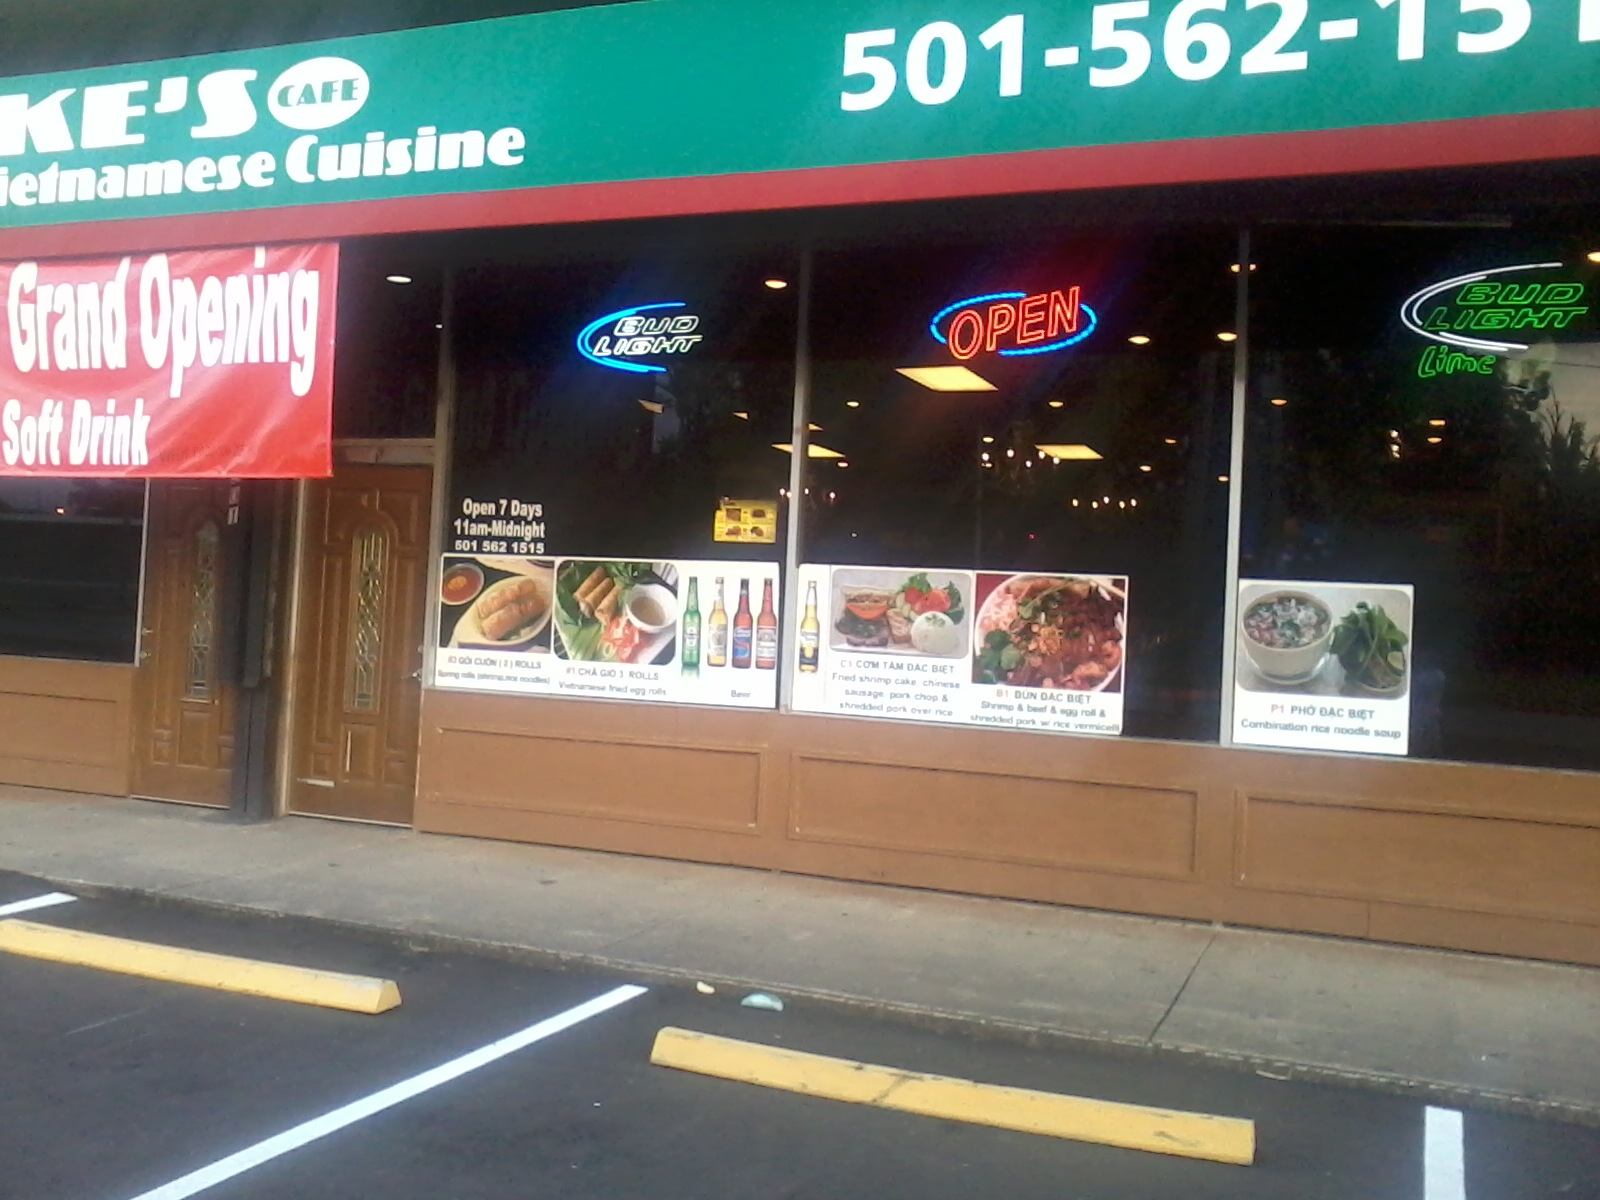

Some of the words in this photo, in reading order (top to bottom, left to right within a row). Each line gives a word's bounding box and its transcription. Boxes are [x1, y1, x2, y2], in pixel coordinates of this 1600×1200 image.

[277, 77, 361, 108] CAFE
[285, 125, 526, 184] Cuisine
[1456, 281, 1585, 305] BUD
[7, 256, 131, 373] Grand
[139, 245, 320, 399] Opening
[613, 315, 700, 336] BUD
[948, 285, 1081, 361] OPEN
[1421, 306, 1590, 331] LIGHT
[592, 335, 703, 356] LIGHT
[1417, 344, 1496, 378] Lime
[2, 398, 63, 466] Soft
[69, 397, 150, 466] Drink
[462, 497, 496, 520] Open
[499, 498, 508, 516] 7
[511, 499, 543, 521] Days
[454, 518, 546, 541] 11am-Midnight
[455, 539, 478, 552] 501
[482, 541, 507, 553] 562
[511, 541, 545, 554] 1515
[628, 670, 660, 681] ROLLS
[832, 672, 856, 682] Fried
[859, 673, 892, 686] shrimp
[894, 677, 917, 686] cake
[922, 677, 961, 689] chinese
[558, 680, 607, 692] Vietnamese
[630, 686, 646, 697] egg
[648, 686, 667, 696] rolls
[731, 689, 751, 698] Beer
[844, 688, 885, 700] sausage
[889, 690, 911, 700] pork
[914, 692, 939, 703] chop
[839, 701, 884, 712] shredded
[886, 704, 908, 714] pork
[911, 706, 932, 715] over
[935, 707, 954, 717] rice
[981, 700, 1014, 712] Shrimp
[1027, 703, 1048, 713] beef
[1060, 707, 1079, 718] egg
[1081, 708, 1097, 717] roll
[969, 713, 1014, 725] shredded
[1016, 716, 1037, 728] pork
[1053, 719, 1071, 728] rice
[1074, 721, 1120, 732] vermicelli
[1240, 717, 1308, 732] Combination
[1311, 723, 1330, 734] rice
[1333, 725, 1371, 737] noodle
[1373, 728, 1402, 740] soup
